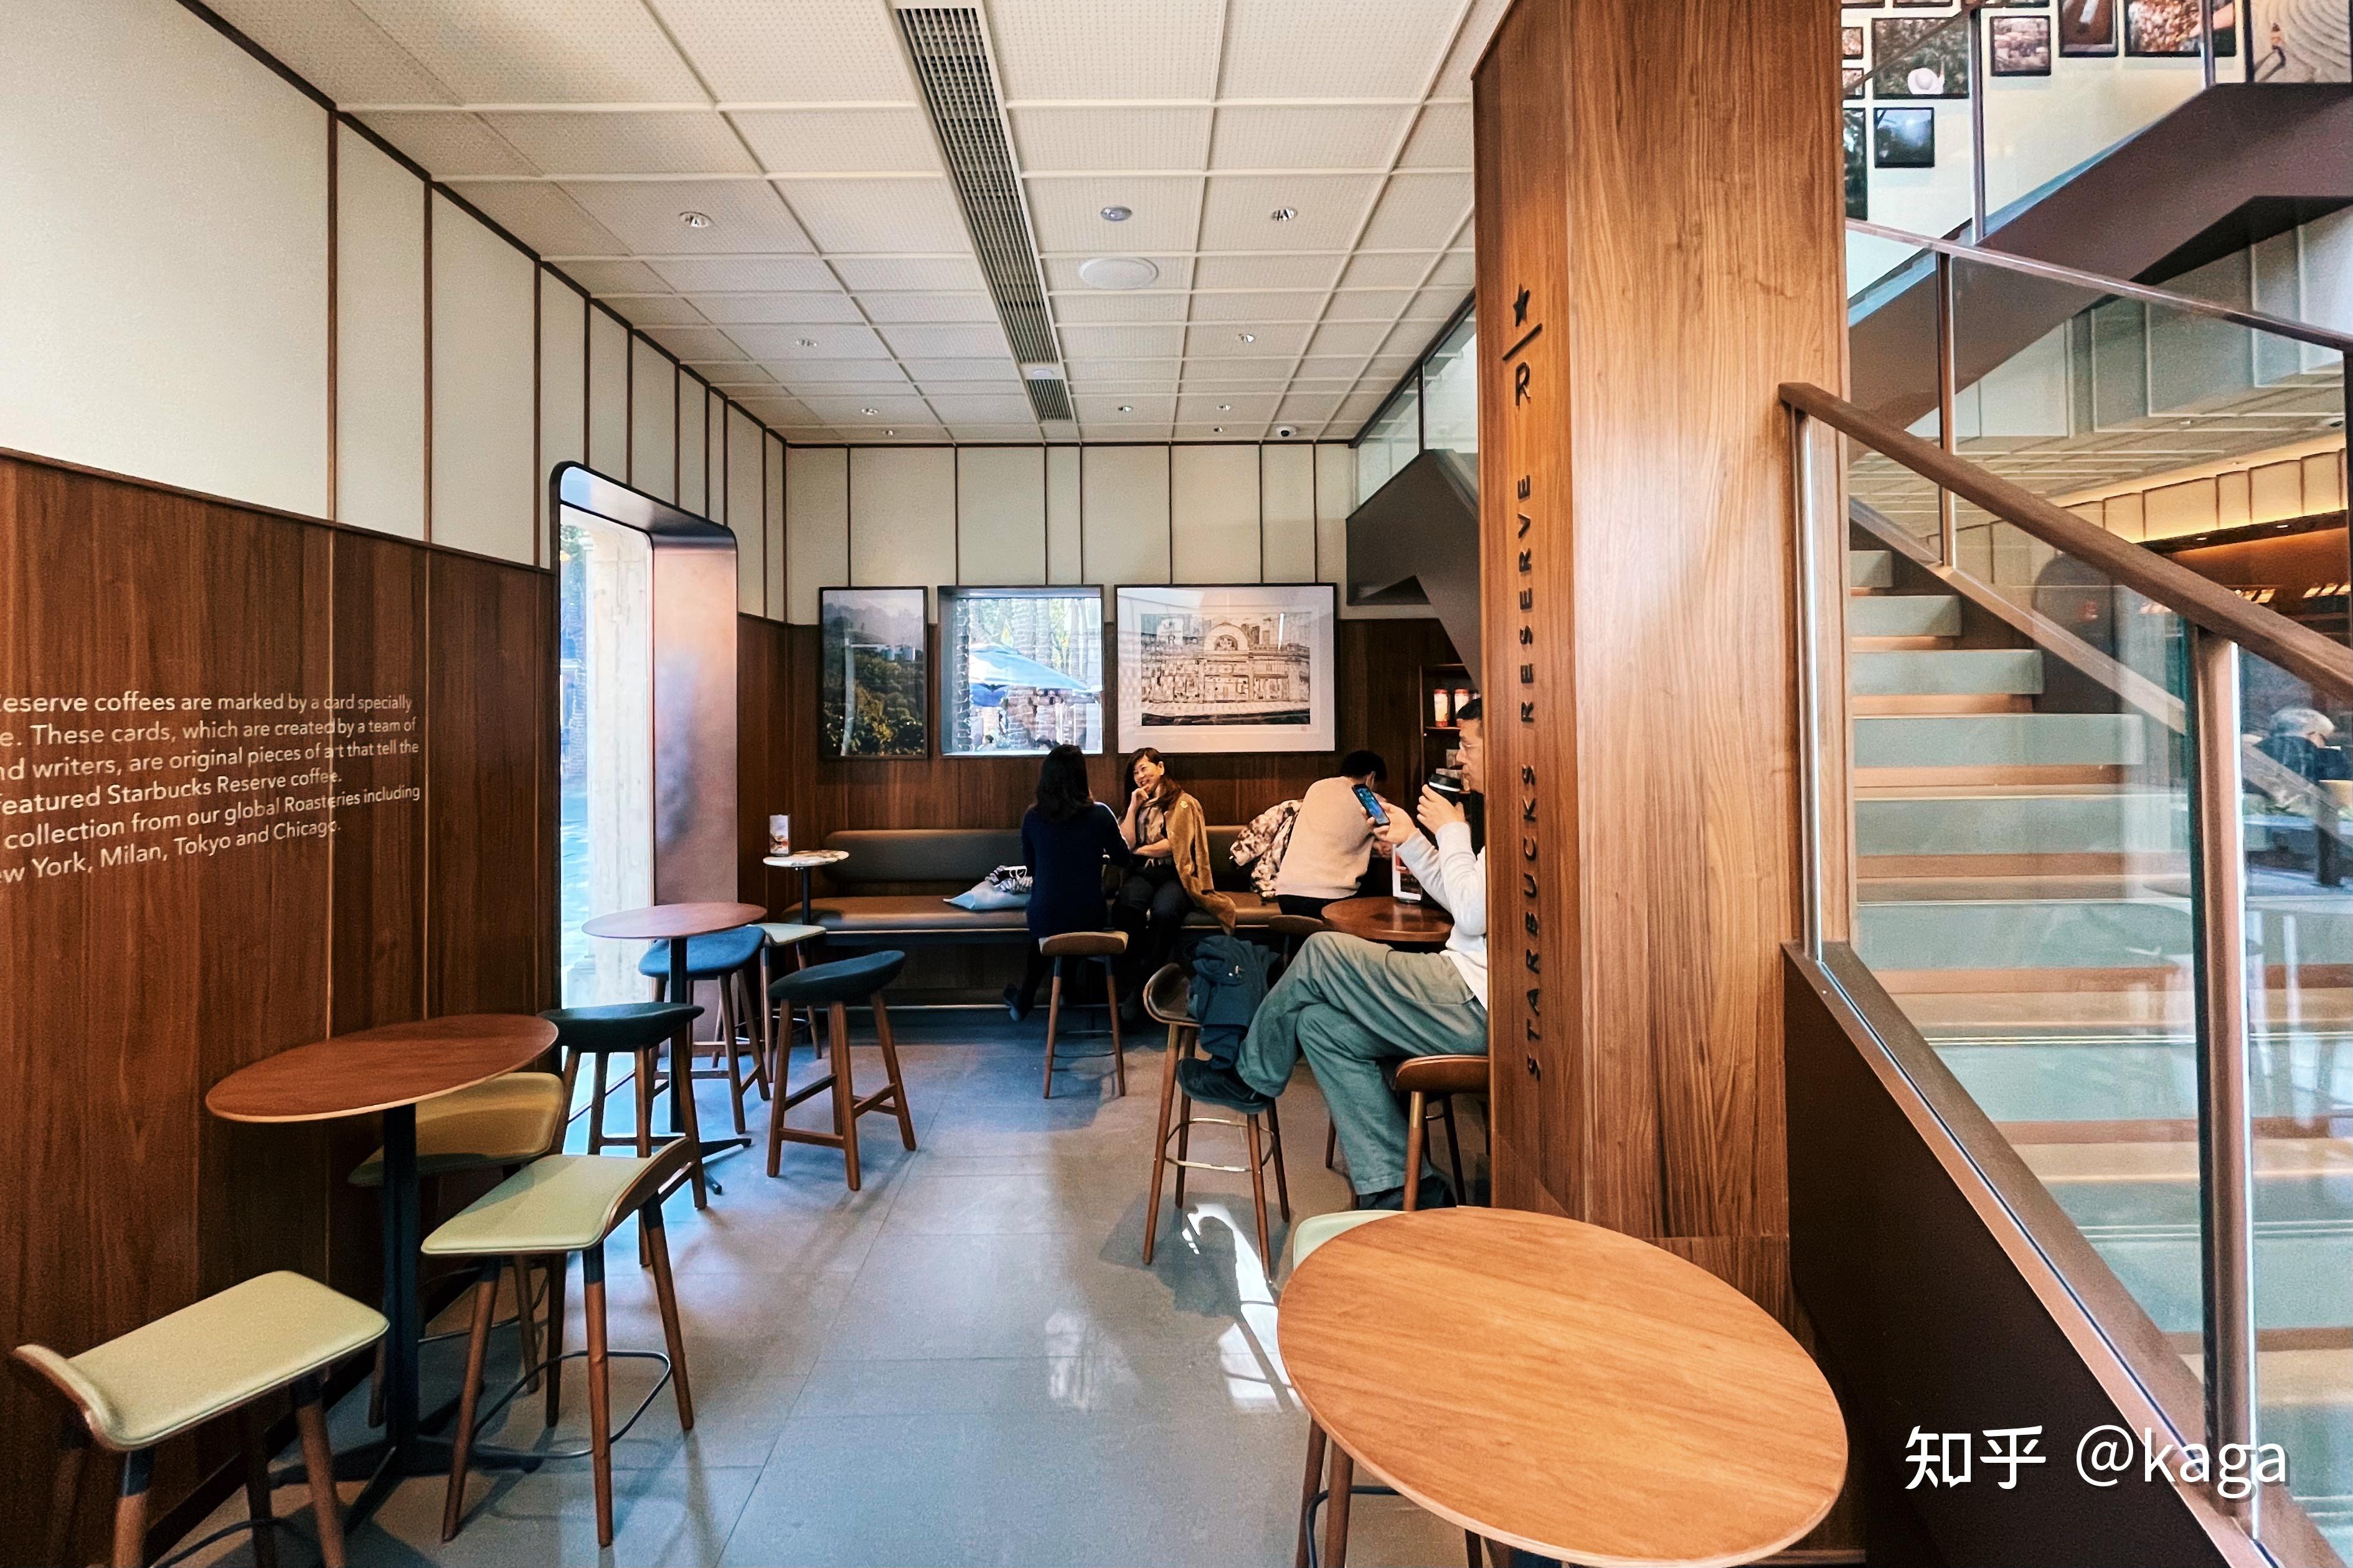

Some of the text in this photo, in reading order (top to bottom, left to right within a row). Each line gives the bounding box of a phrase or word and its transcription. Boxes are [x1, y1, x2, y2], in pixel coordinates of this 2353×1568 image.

[0, 690, 412, 714] eserve coffees are marked by a card specially
[30, 723, 105, 746] These
[111, 720, 176, 743] cards,
[182, 720, 238, 739] which
[243, 724, 270, 737] are
[275, 718, 335, 736] created
[337, 718, 354, 738] by
[357, 722, 365, 733] a
[369, 720, 400, 733] team
[404, 716, 417, 731] of
[32, 756, 122, 778] writers,
[130, 756, 163, 772] are
[169, 746, 242, 772] original
[248, 746, 301, 768] pieces
[304, 742, 321, 759] of
[347, 741, 374, 757] that
[377, 739, 396, 755] tell
[399, 739, 419, 753] the
[1517, 474, 1541, 1082] STARBUCKS RESERVE
[0, 767, 342, 815] eatured Starbucks Reserve coffee.
[4, 784, 420, 849] collection from our global Roasteries including
[0, 820, 341, 883] w York, Milan, Tokyo and Chicago.
